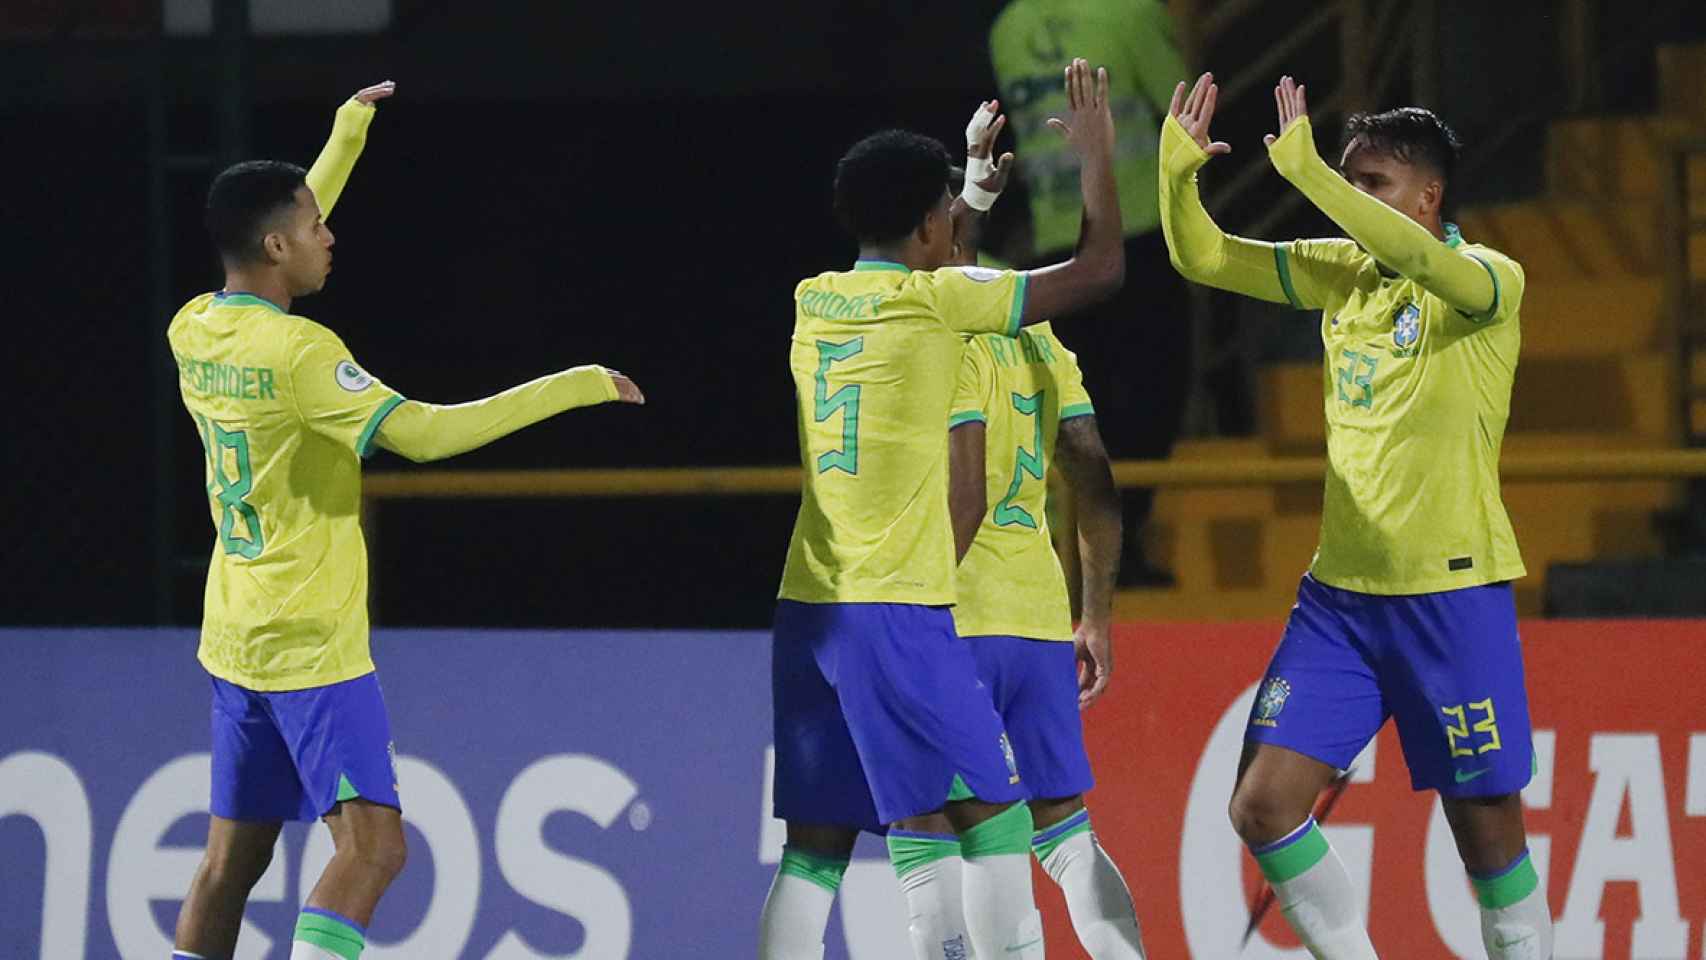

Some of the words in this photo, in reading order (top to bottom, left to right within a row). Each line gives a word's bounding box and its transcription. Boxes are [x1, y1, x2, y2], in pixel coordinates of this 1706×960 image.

[814, 336, 864, 475] 5
[1337, 350, 1377, 409] 23
[993, 389, 1045, 528] 2
[1441, 697, 1502, 758] 23
[1424, 729, 1706, 960] GA
